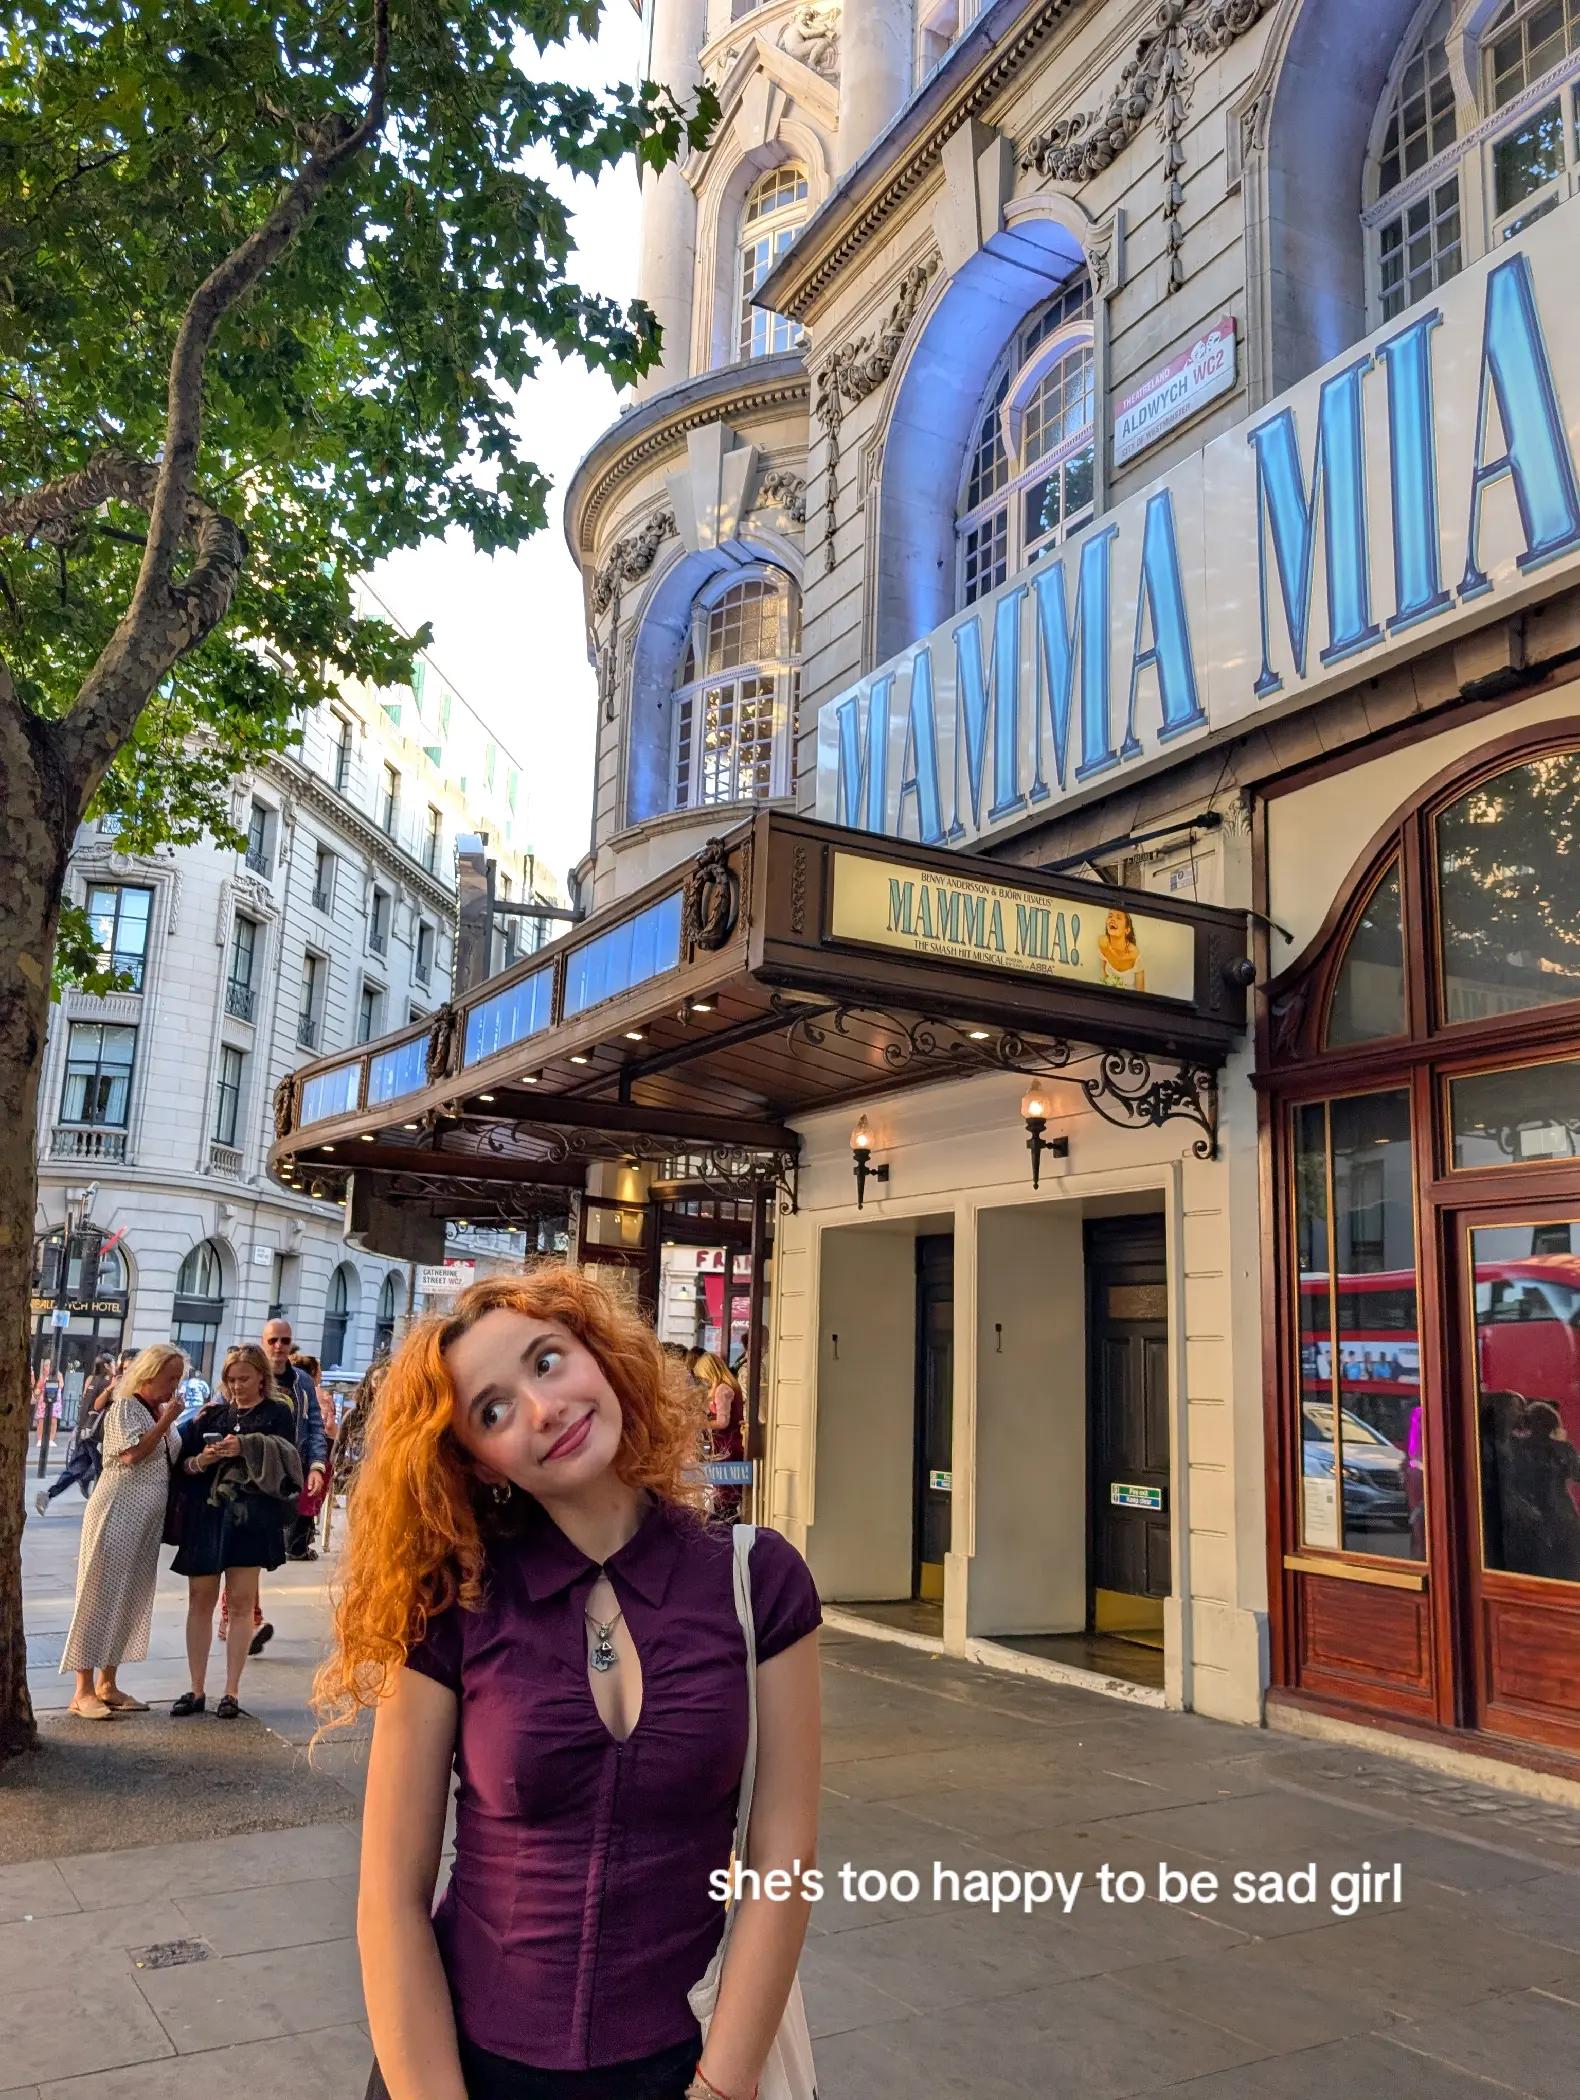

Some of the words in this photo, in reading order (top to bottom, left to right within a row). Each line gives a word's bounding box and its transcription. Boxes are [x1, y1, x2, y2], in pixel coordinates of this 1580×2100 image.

[1122, 375, 1188, 439] ALDWYCH
[1193, 349, 1225, 385] WC2
[834, 486, 1209, 848] MAMMA
[1246, 251, 1580, 700] MIA
[921, 871, 945, 886] BENNY
[946, 879, 990, 896] ANDERSSON
[991, 888, 998, 896] &
[886, 877, 1007, 954] MAMMA
[1014, 903, 1081, 967] MIA!
[914, 939, 929, 950] THE
[930, 942, 957, 957] SMASH
[958, 946, 971, 958] HIT
[972, 950, 1006, 966] MUSICAL
[422, 1276, 447, 1285] STREET
[448, 1278, 463, 1286] WC2
[423, 1268, 458, 1277] CATHERINE
[91, 1301, 122, 1313] HOTEL
